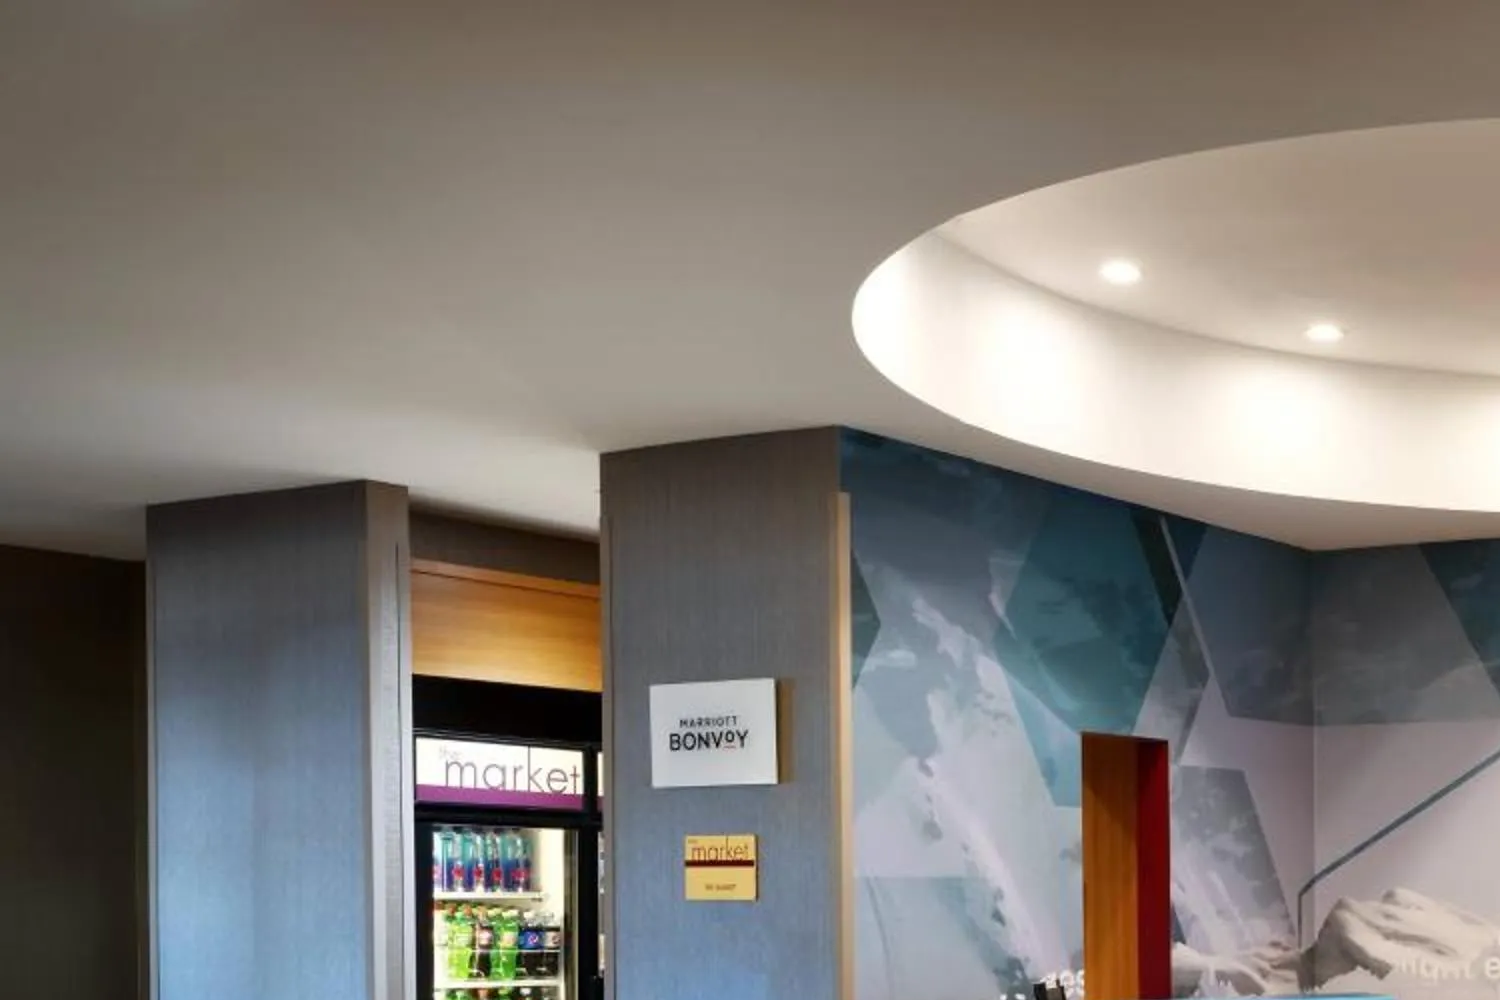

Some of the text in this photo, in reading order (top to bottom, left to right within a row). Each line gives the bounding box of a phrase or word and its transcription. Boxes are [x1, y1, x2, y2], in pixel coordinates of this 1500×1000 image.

[679, 715, 737, 728] MARRIOTT
[669, 730, 749, 751] BONVOY
[445, 745, 580, 795] market
[691, 836, 749, 861] market
